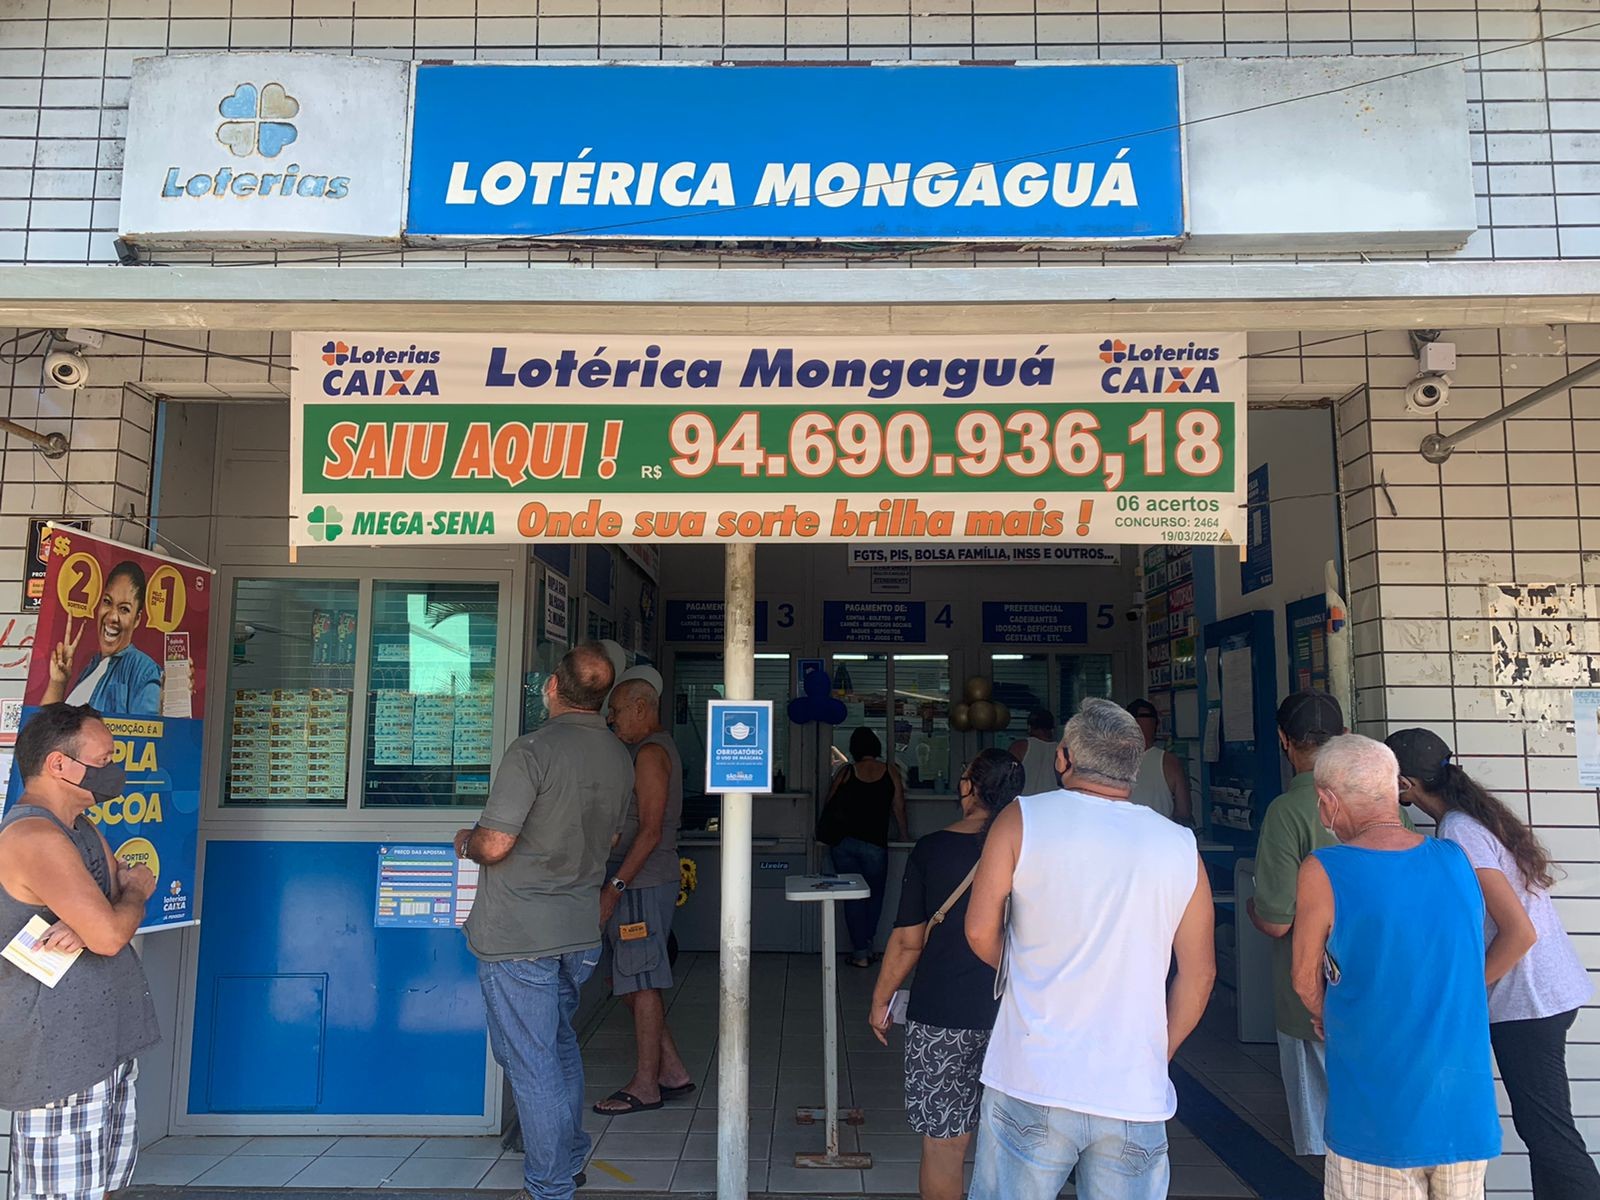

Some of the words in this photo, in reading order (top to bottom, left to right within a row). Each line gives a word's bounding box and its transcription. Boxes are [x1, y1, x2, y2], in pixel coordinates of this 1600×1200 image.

[161, 163, 351, 200] Loterias
[445, 147, 738, 208] LOTÉRICA
[752, 147, 1139, 208] MONGAGUÁ
[349, 344, 440, 364] Loterias
[1127, 342, 1220, 361] Loterias
[322, 369, 440, 396] CAIXA
[485, 344, 722, 388] Lotérica
[739, 344, 1055, 399] Mongaguá
[1101, 366, 1220, 394] CAIXA
[322, 421, 449, 480] SAIU
[451, 421, 588, 487] AQUI
[641, 465, 662, 480] R$
[668, 408, 1224, 491] 94.690.936,18
[1116, 495, 1140, 512] 06
[1146, 495, 1220, 512] acertos
[351, 511, 495, 536] MEGA-SENA
[517, 499, 623, 538] Onde
[632, 510, 707, 538] sua
[715, 505, 820, 538] sorte
[830, 498, 955, 537] brilha
[963, 498, 1064, 537] mais
[1114, 516, 1190, 528] CONCURSO:
[1194, 516, 1219, 528] 2464
[1160, 531, 1219, 542] 19/03/2022
[854, 550, 888, 562] FGTS,
[890, 549, 912, 562] PIS,
[915, 549, 955, 560] BOLSA
[958, 546, 1010, 561] FAMÍLIA,
[1013, 548, 1041, 560] INSS
[1044, 548, 1051, 559] E
[1054, 548, 1114, 559] OUTROS...
[68, 560, 92, 604] 2
[160, 575, 176, 623] 1
[844, 604, 893, 612] PAGAMENTO
[1003, 603, 1064, 612] PREFERENCIAL
[776, 603, 795, 628] 3
[934, 604, 953, 628] 4
[1009, 615, 1058, 623] CADEIRANTES
[1096, 604, 1115, 629] 5
[995, 624, 1022, 632] IDOSOS
[1027, 624, 1073, 633] DEFICIENTES
[1005, 634, 1042, 642] GESTANTE
[112, 740, 158, 772] PLA
[163, 901, 187, 912] CAIXA
